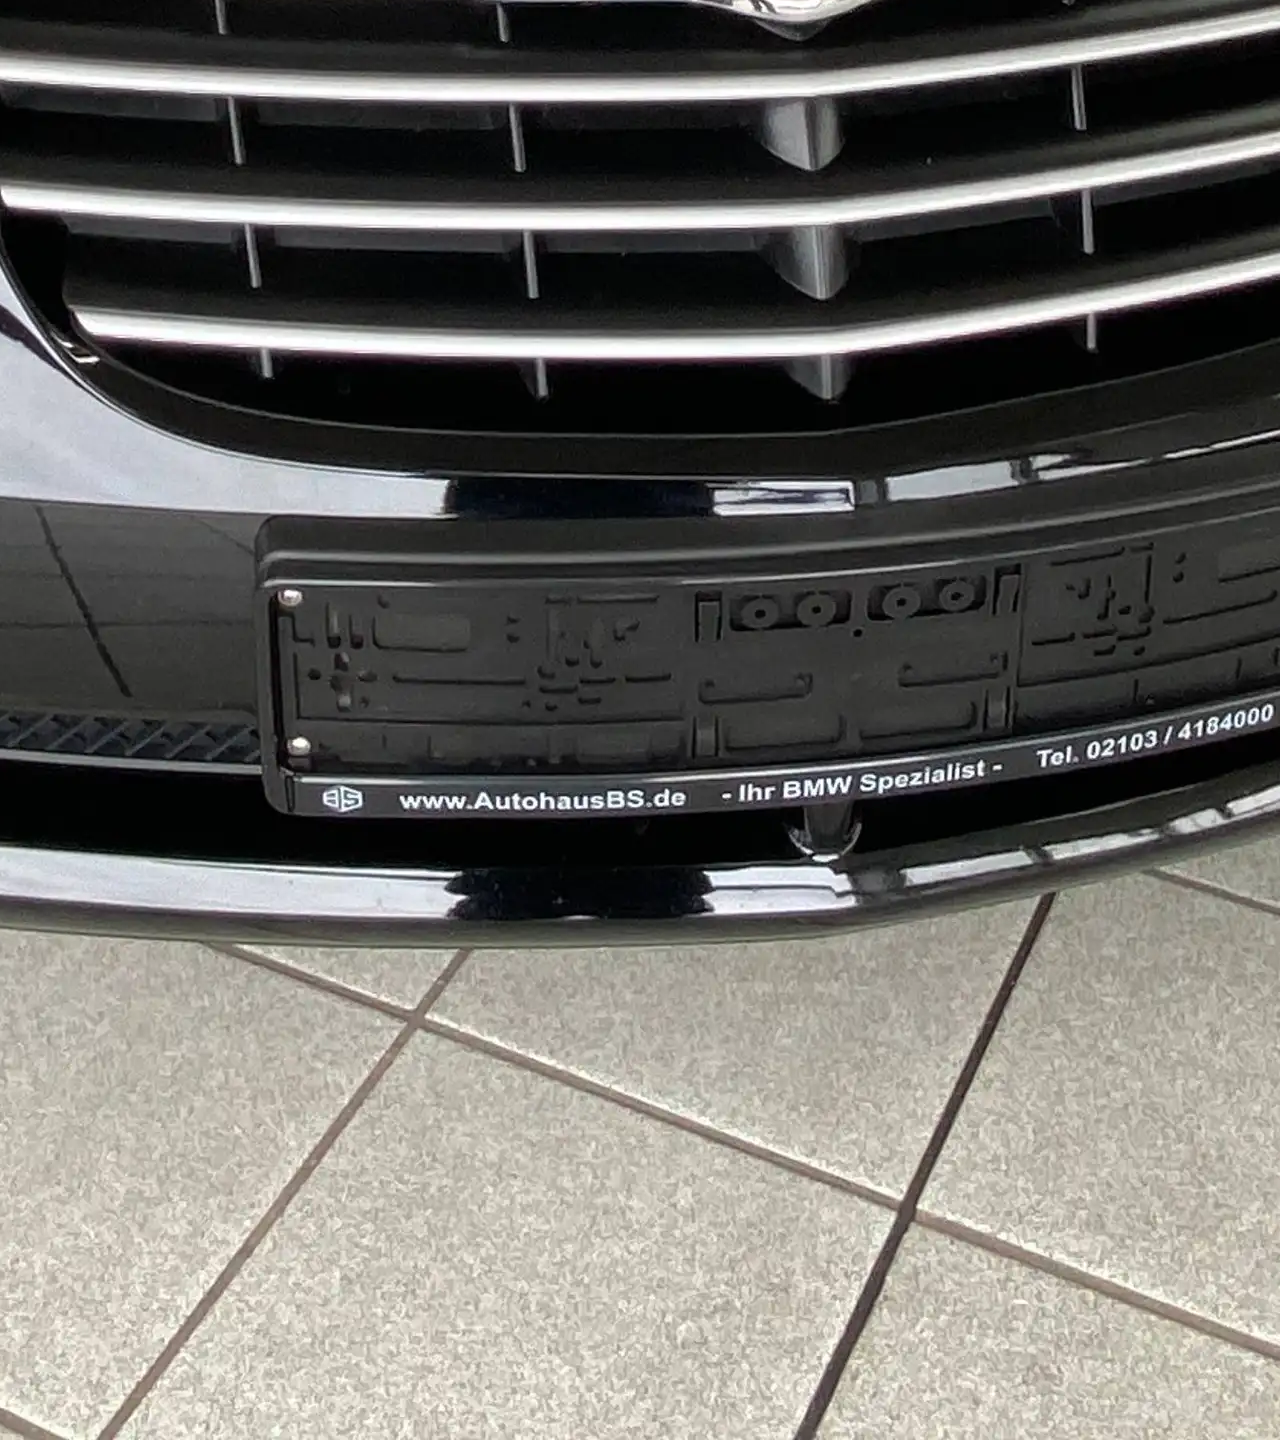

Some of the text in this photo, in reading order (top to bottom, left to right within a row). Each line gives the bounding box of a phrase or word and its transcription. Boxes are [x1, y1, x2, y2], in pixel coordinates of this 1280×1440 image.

[399, 789, 687, 811] www.AutohausBS.de
[737, 783, 777, 803] Ihr
[782, 775, 853, 799] BMW
[859, 759, 986, 795] Spezialist
[1036, 745, 1080, 769] Tel.
[1086, 729, 1158, 761] 02103
[1177, 703, 1275, 742] 4184000
